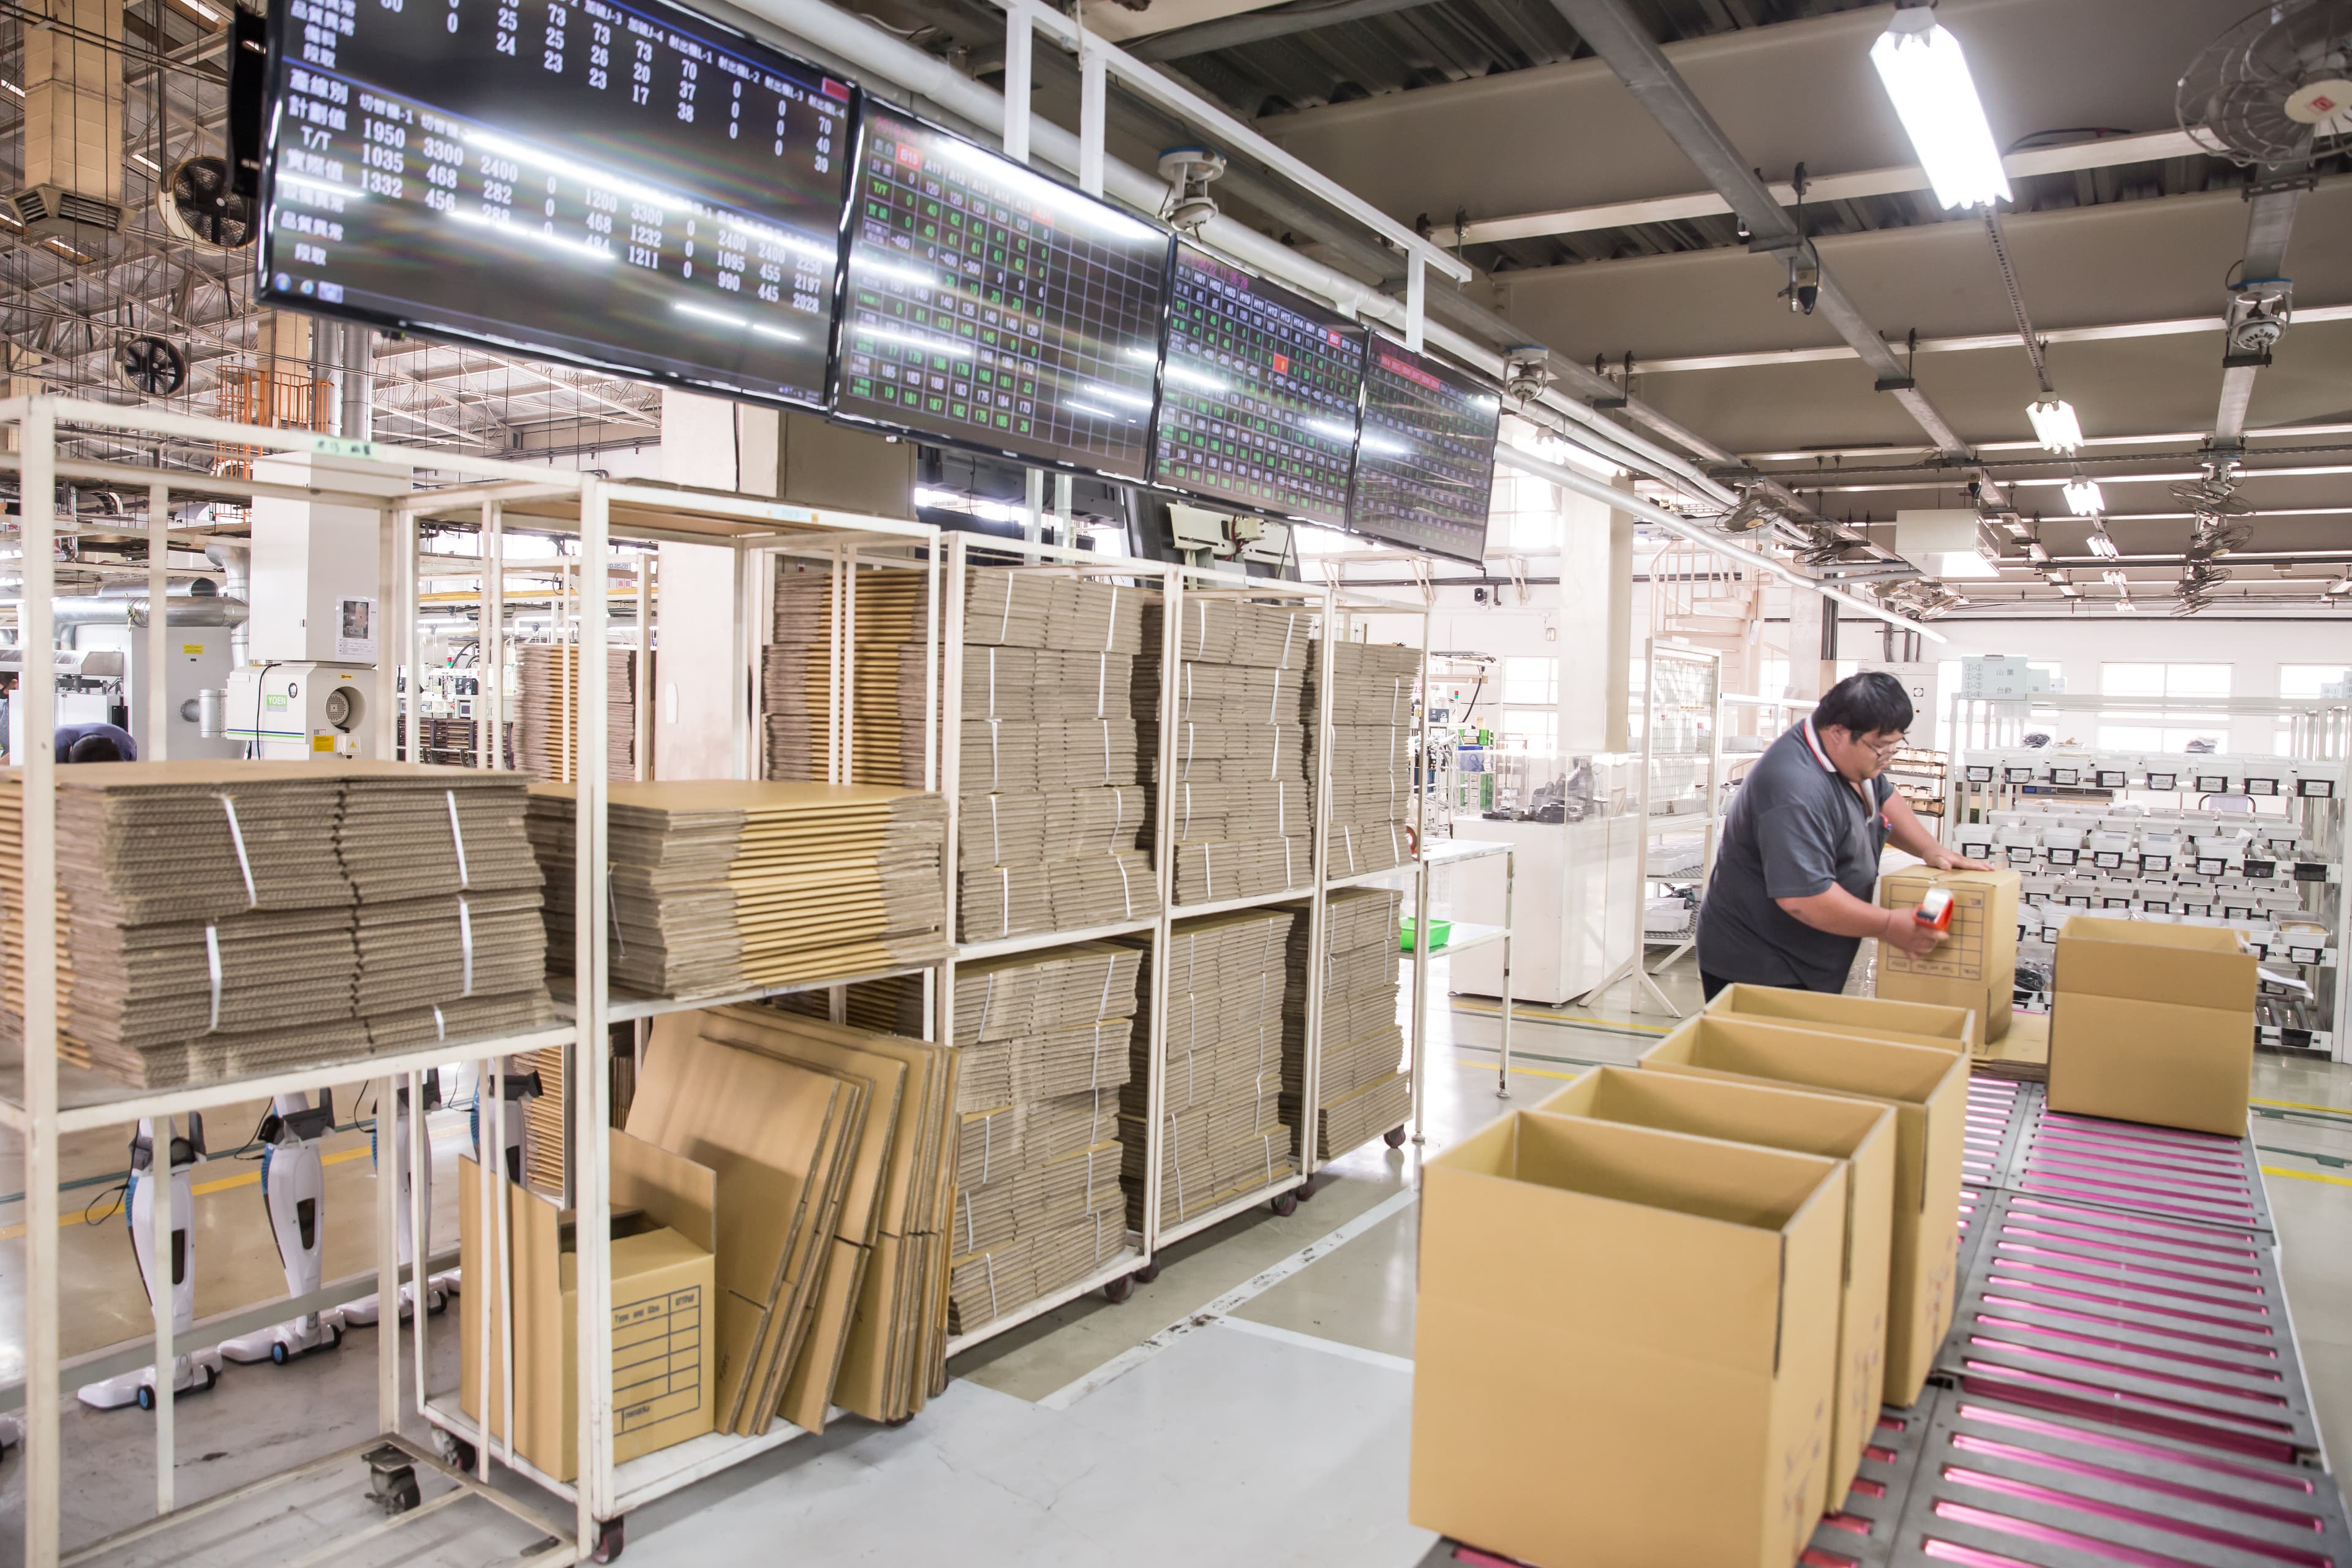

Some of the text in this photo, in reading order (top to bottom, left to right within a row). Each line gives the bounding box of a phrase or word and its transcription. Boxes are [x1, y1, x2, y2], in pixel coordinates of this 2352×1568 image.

[446, 12, 458, 33] 0
[497, 7, 518, 31] 25
[545, 26, 564, 50] 25
[633, 62, 650, 83] 20
[679, 80, 696, 101] 37
[731, 101, 739, 119] 0
[777, 119, 785, 136] 0
[816, 136, 830, 154] 40
[548, 3, 832, 135] 73 73 73 70 0 0 70
[496, 31, 829, 173] 24 23 23 17 38 0 0 39
[300, 125, 821, 294] T/T 1035 468 282 0 468 1232 0 1095 455 2197
[361, 169, 403, 198] 1332
[424, 187, 456, 211] 456
[628, 245, 658, 270] 1211
[683, 261, 692, 278] 0
[718, 271, 741, 292] 990
[758, 282, 779, 303] 445
[793, 292, 819, 314] 2028
[364, 118, 405, 149] 1950
[423, 137, 464, 167] 3300
[480, 155, 518, 183] 2400
[547, 176, 556, 194] 0
[585, 187, 617, 213] 1200
[631, 202, 663, 227] 3300
[687, 219, 696, 236] 0
[718, 229, 747, 252] 2400
[758, 242, 785, 265] 2400
[873, 181, 888, 195] T/T
[926, 181, 940, 197] 120
[950, 191, 963, 206] 120
[973, 200, 986, 214] 120
